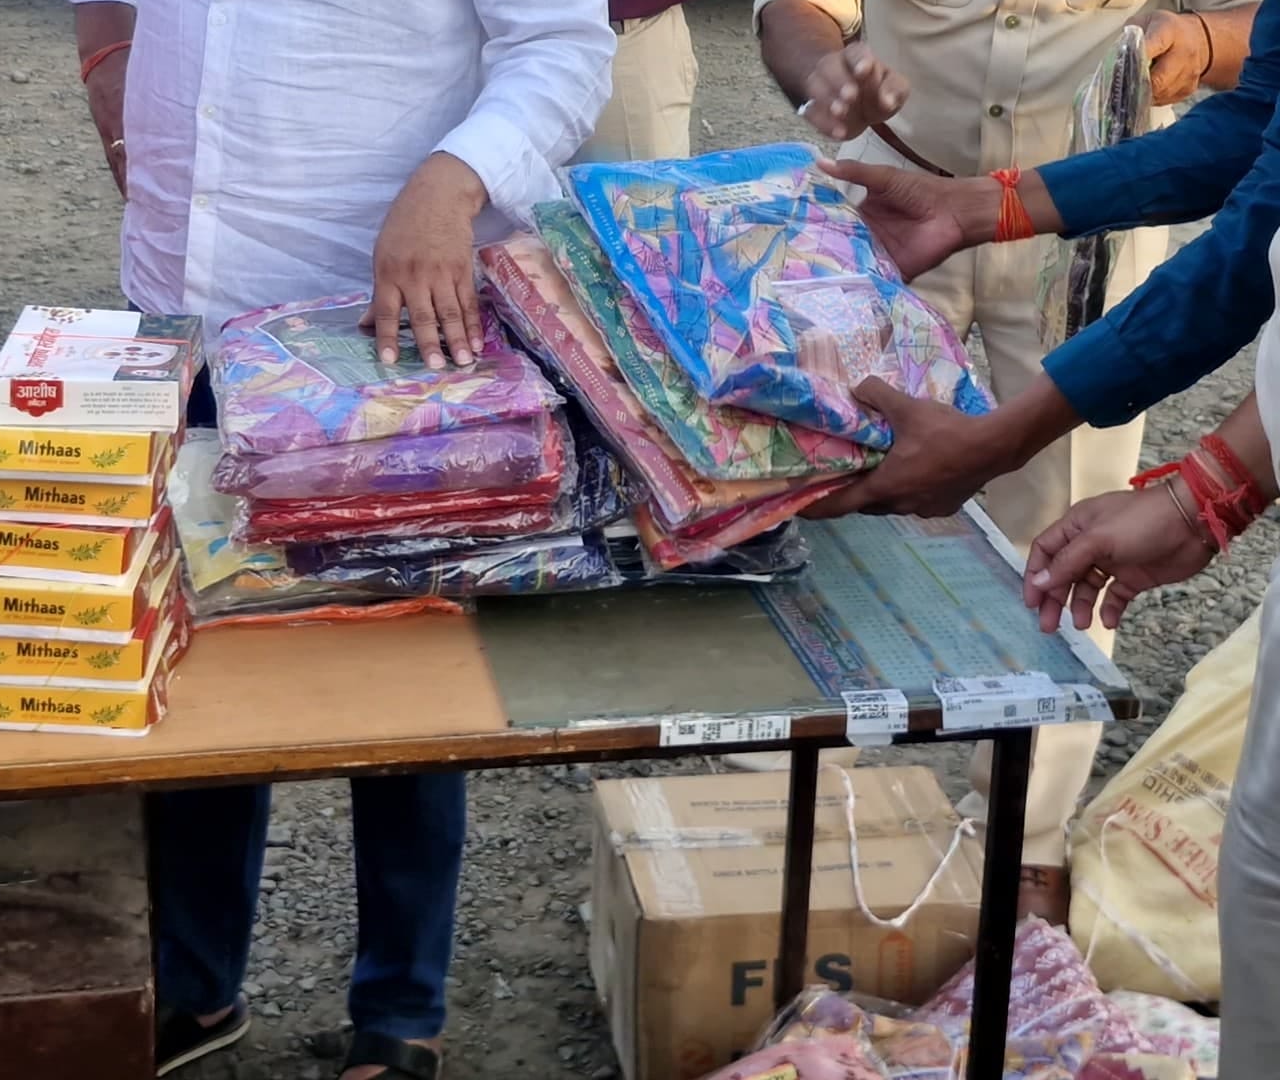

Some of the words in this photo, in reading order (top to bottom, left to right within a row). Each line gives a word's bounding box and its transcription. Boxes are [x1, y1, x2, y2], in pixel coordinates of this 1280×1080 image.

[16, 382, 58, 400] आशीष
[18, 439, 82, 459] Mithaas
[24, 486, 86, 505] Mithaas
[3, 597, 65, 615] Mithaas
[16, 642, 78, 659] Mithaas
[20, 697, 81, 715] Mithaas
[731, 953, 854, 1007] FS
